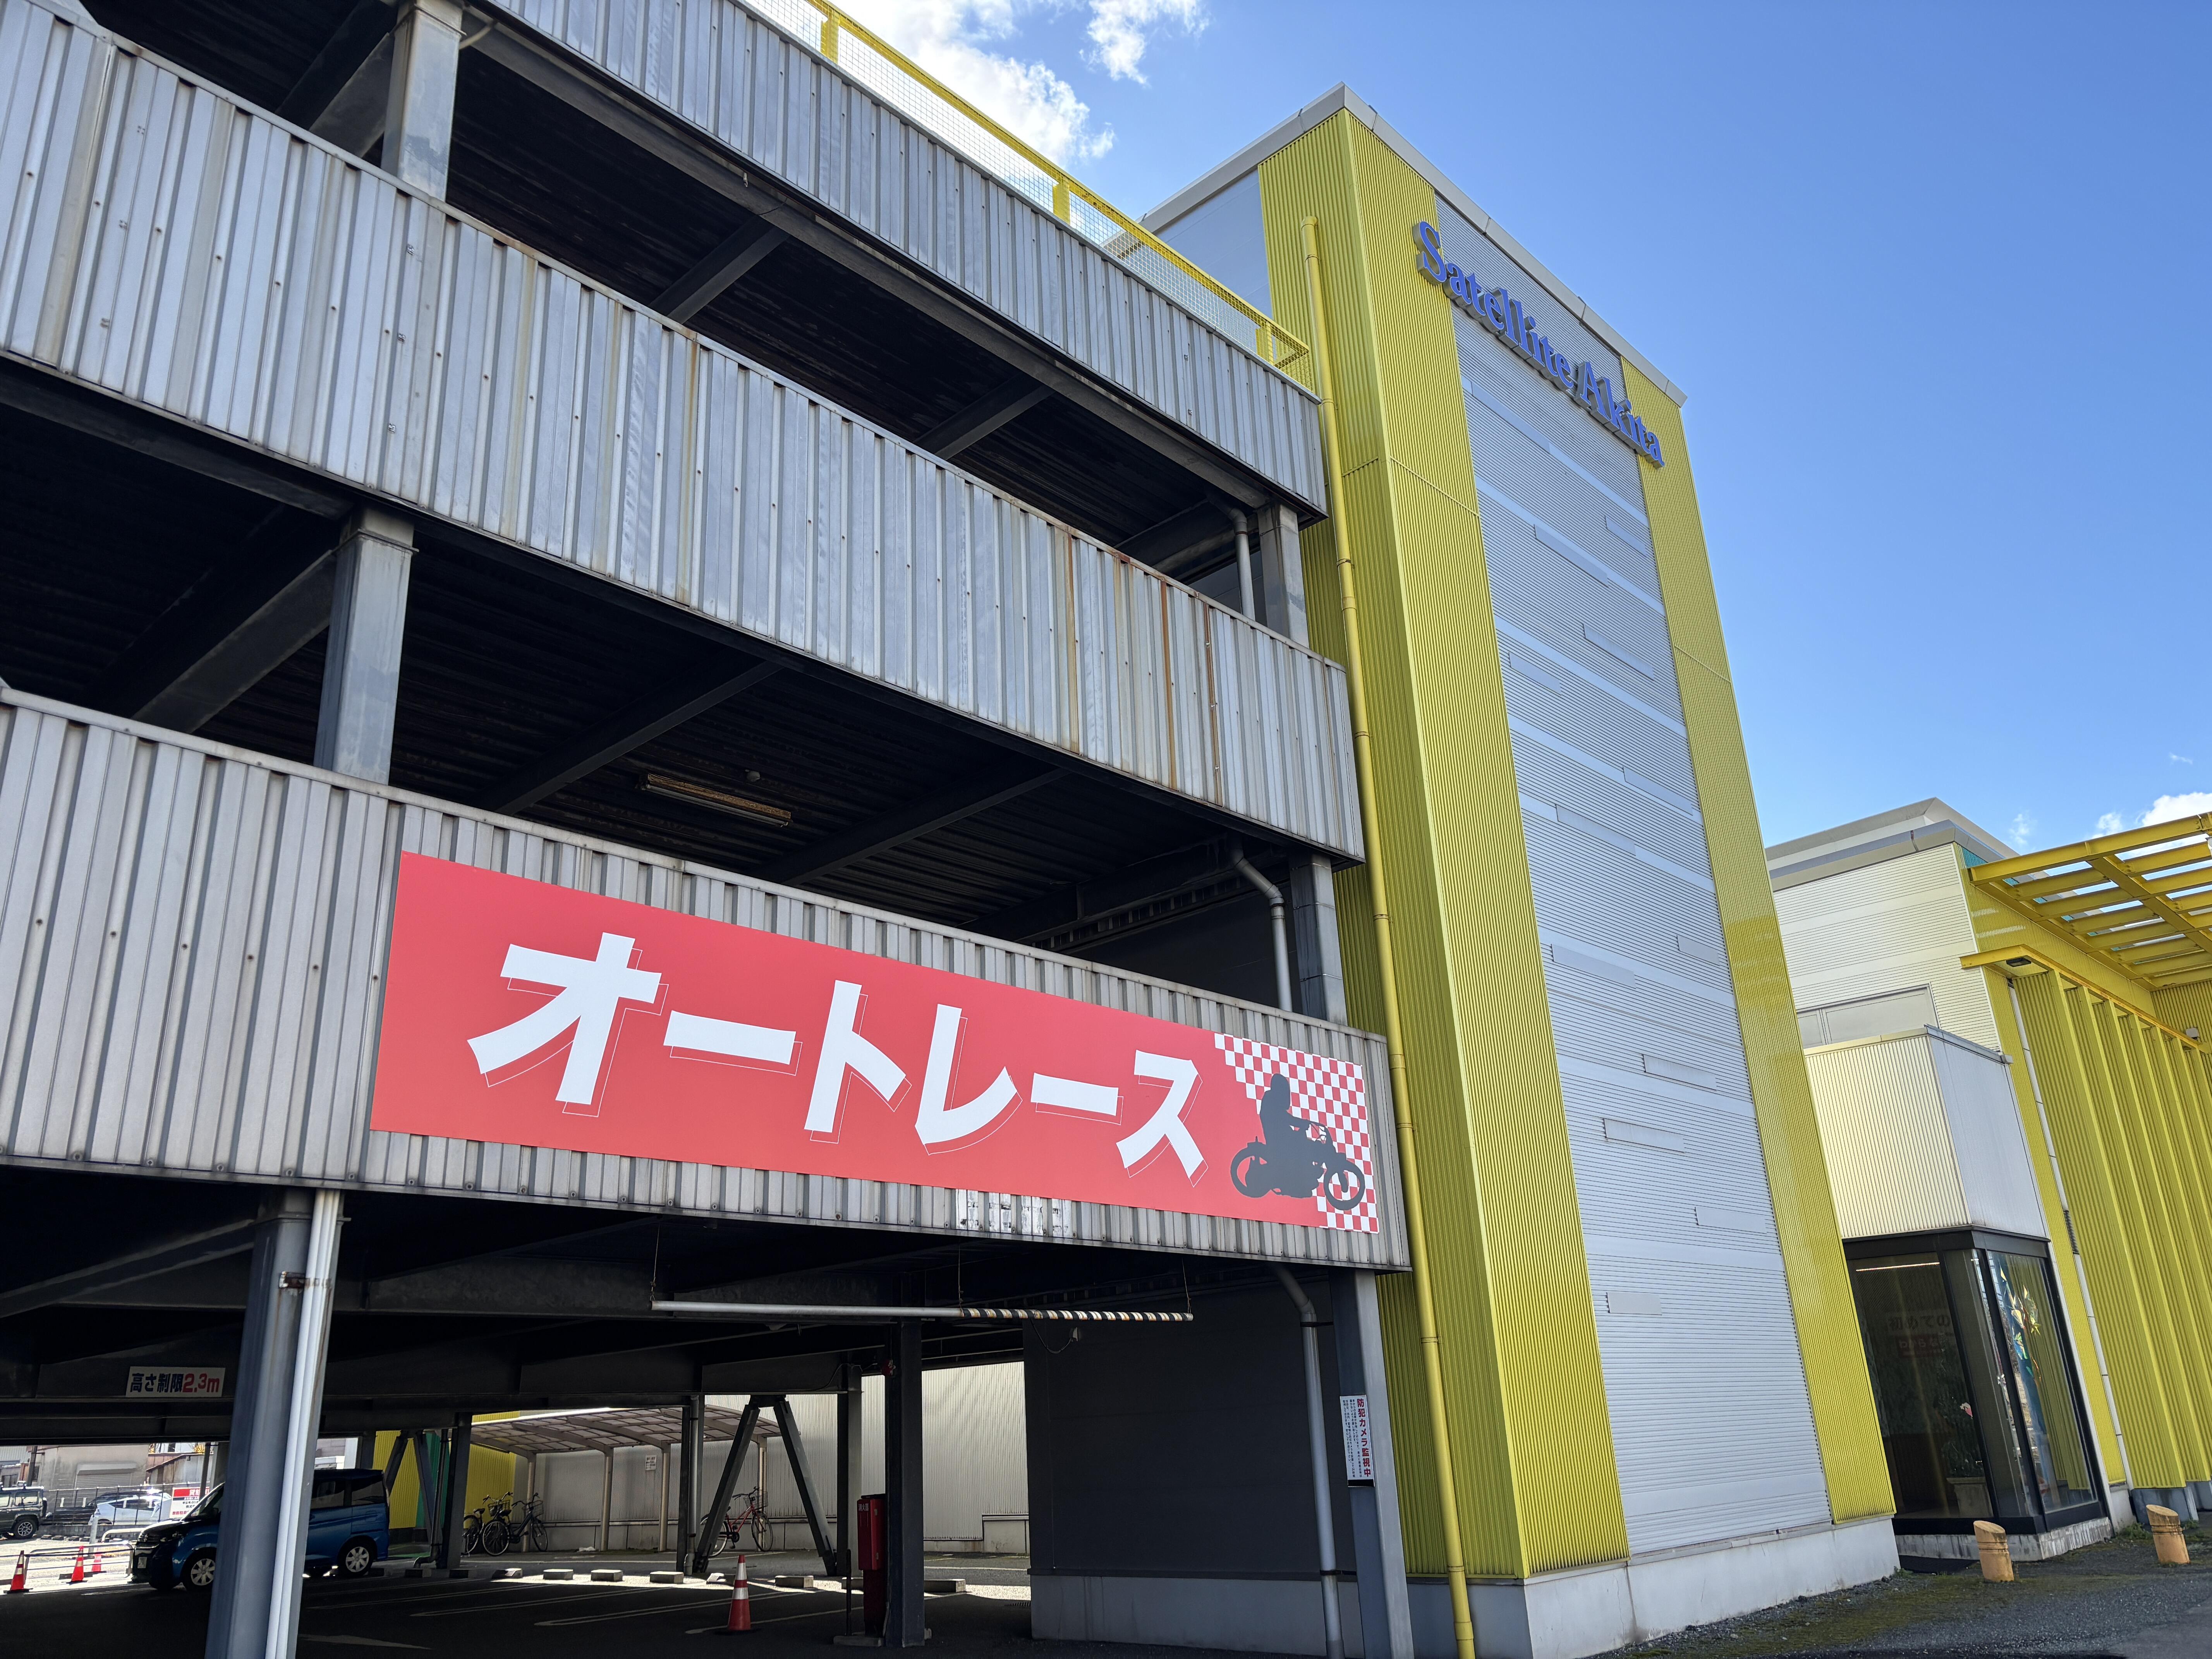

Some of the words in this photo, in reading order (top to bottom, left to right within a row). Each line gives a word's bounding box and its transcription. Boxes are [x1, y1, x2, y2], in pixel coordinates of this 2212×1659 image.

[1413, 221, 1574, 390] Satellite
[1575, 361, 1665, 469] Akita
[467, 932, 1206, 1185] オートレース
[130, 1373, 220, 1393] 高さ制限2.3m
[1357, 1398, 1371, 1477] 防犯カメラ監視中
